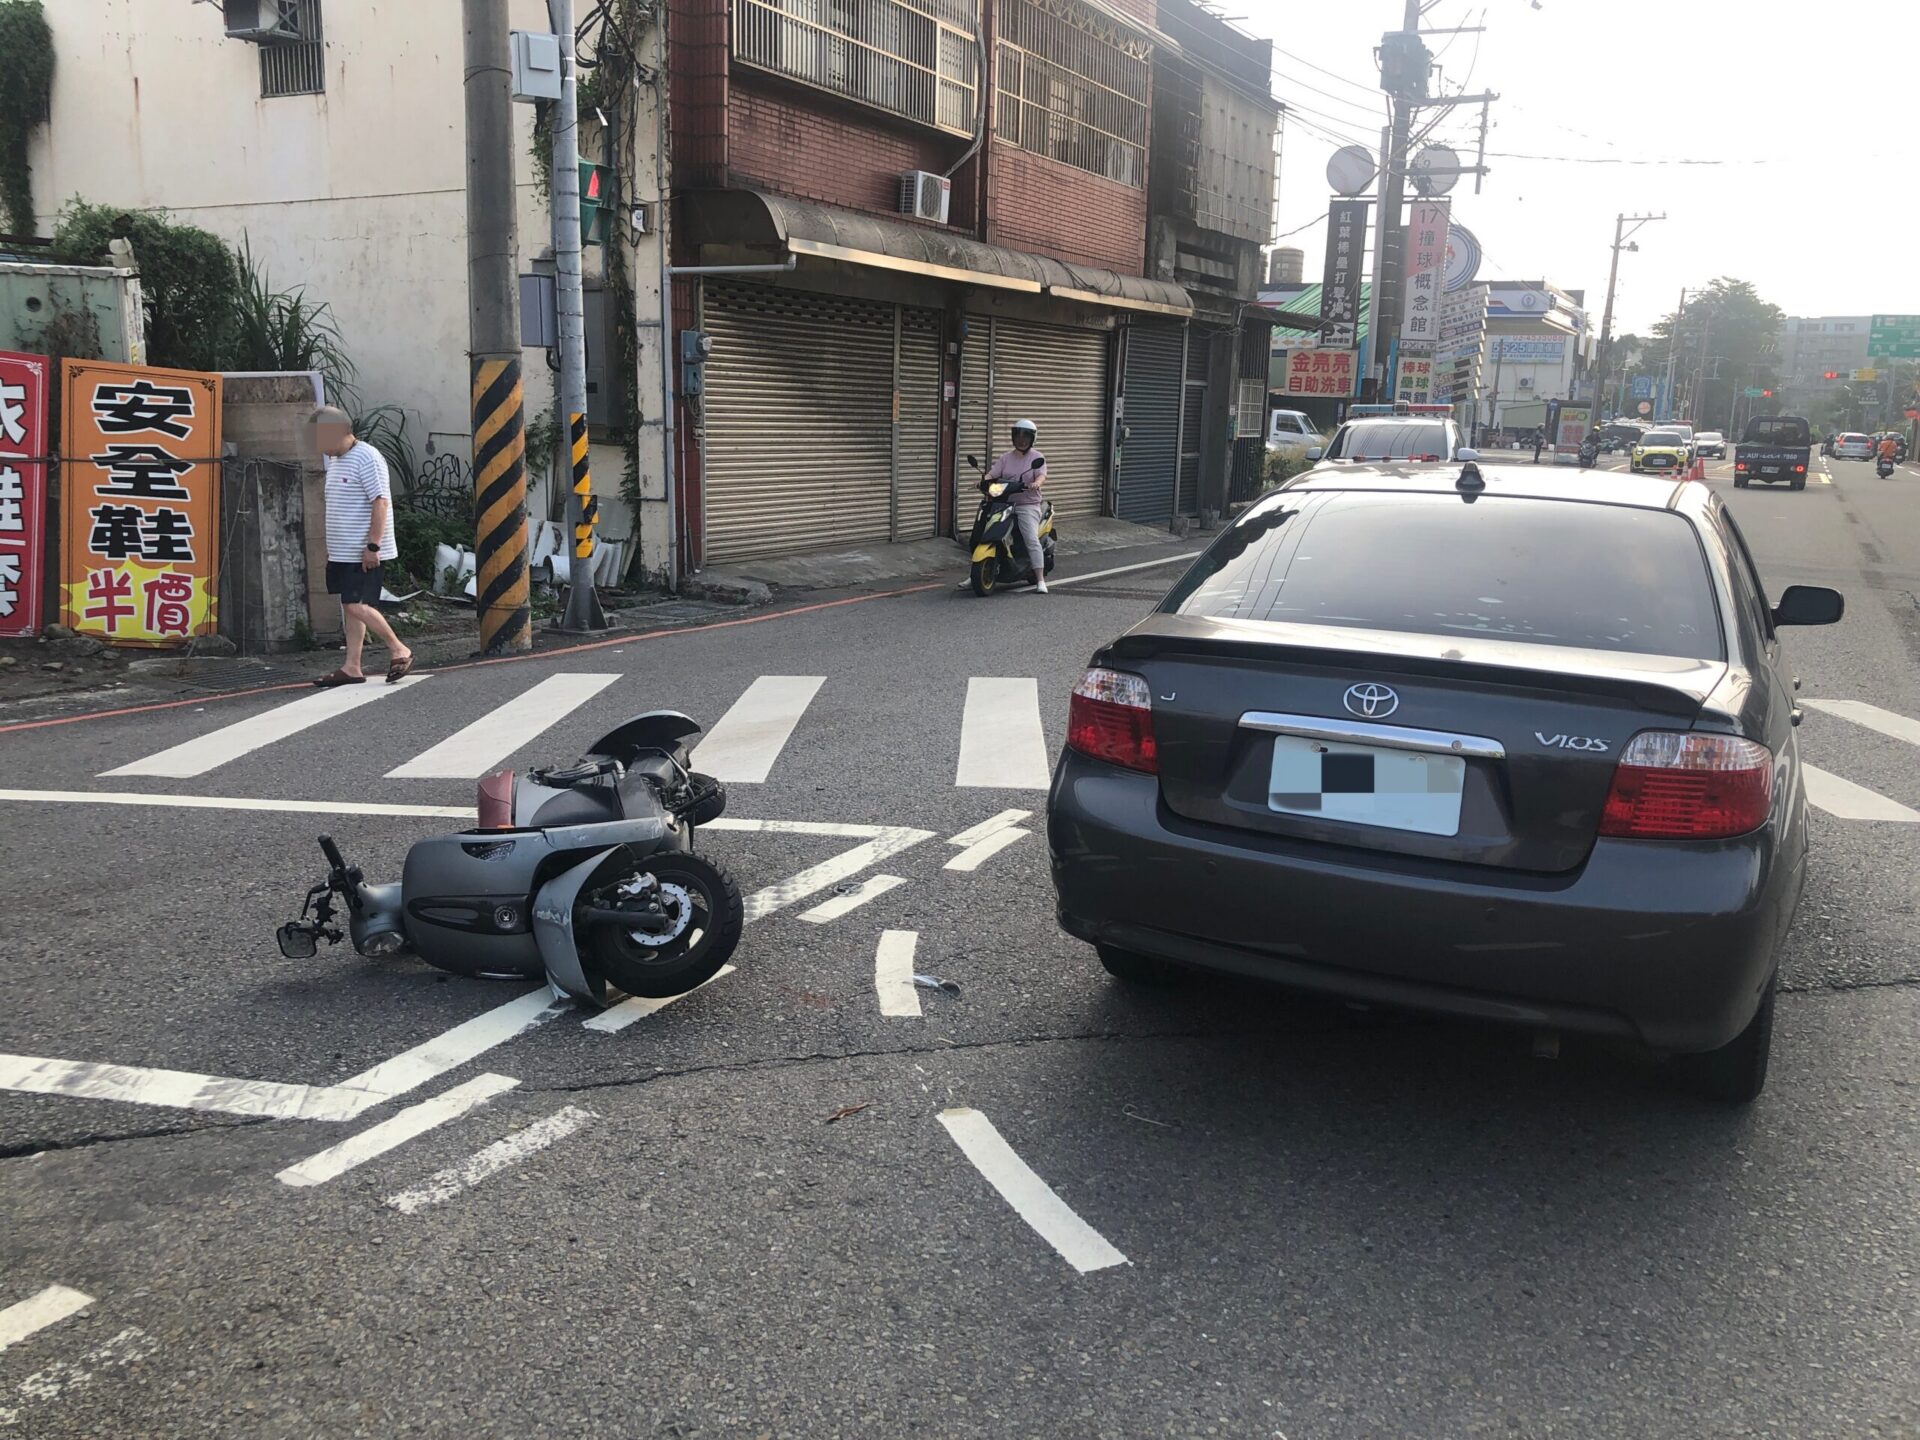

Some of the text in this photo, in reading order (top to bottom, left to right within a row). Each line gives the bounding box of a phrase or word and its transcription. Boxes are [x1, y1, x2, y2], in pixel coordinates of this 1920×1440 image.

[1409, 208, 1439, 333] 17撞球概念館
[1291, 351, 1352, 373] 金亮亮
[1402, 360, 1430, 374] 棒球
[1288, 375, 1351, 394] 自助洗車
[89, 379, 195, 563] 安全鞋
[84, 568, 194, 636] 半價
[1534, 731, 1612, 752] VIOS
